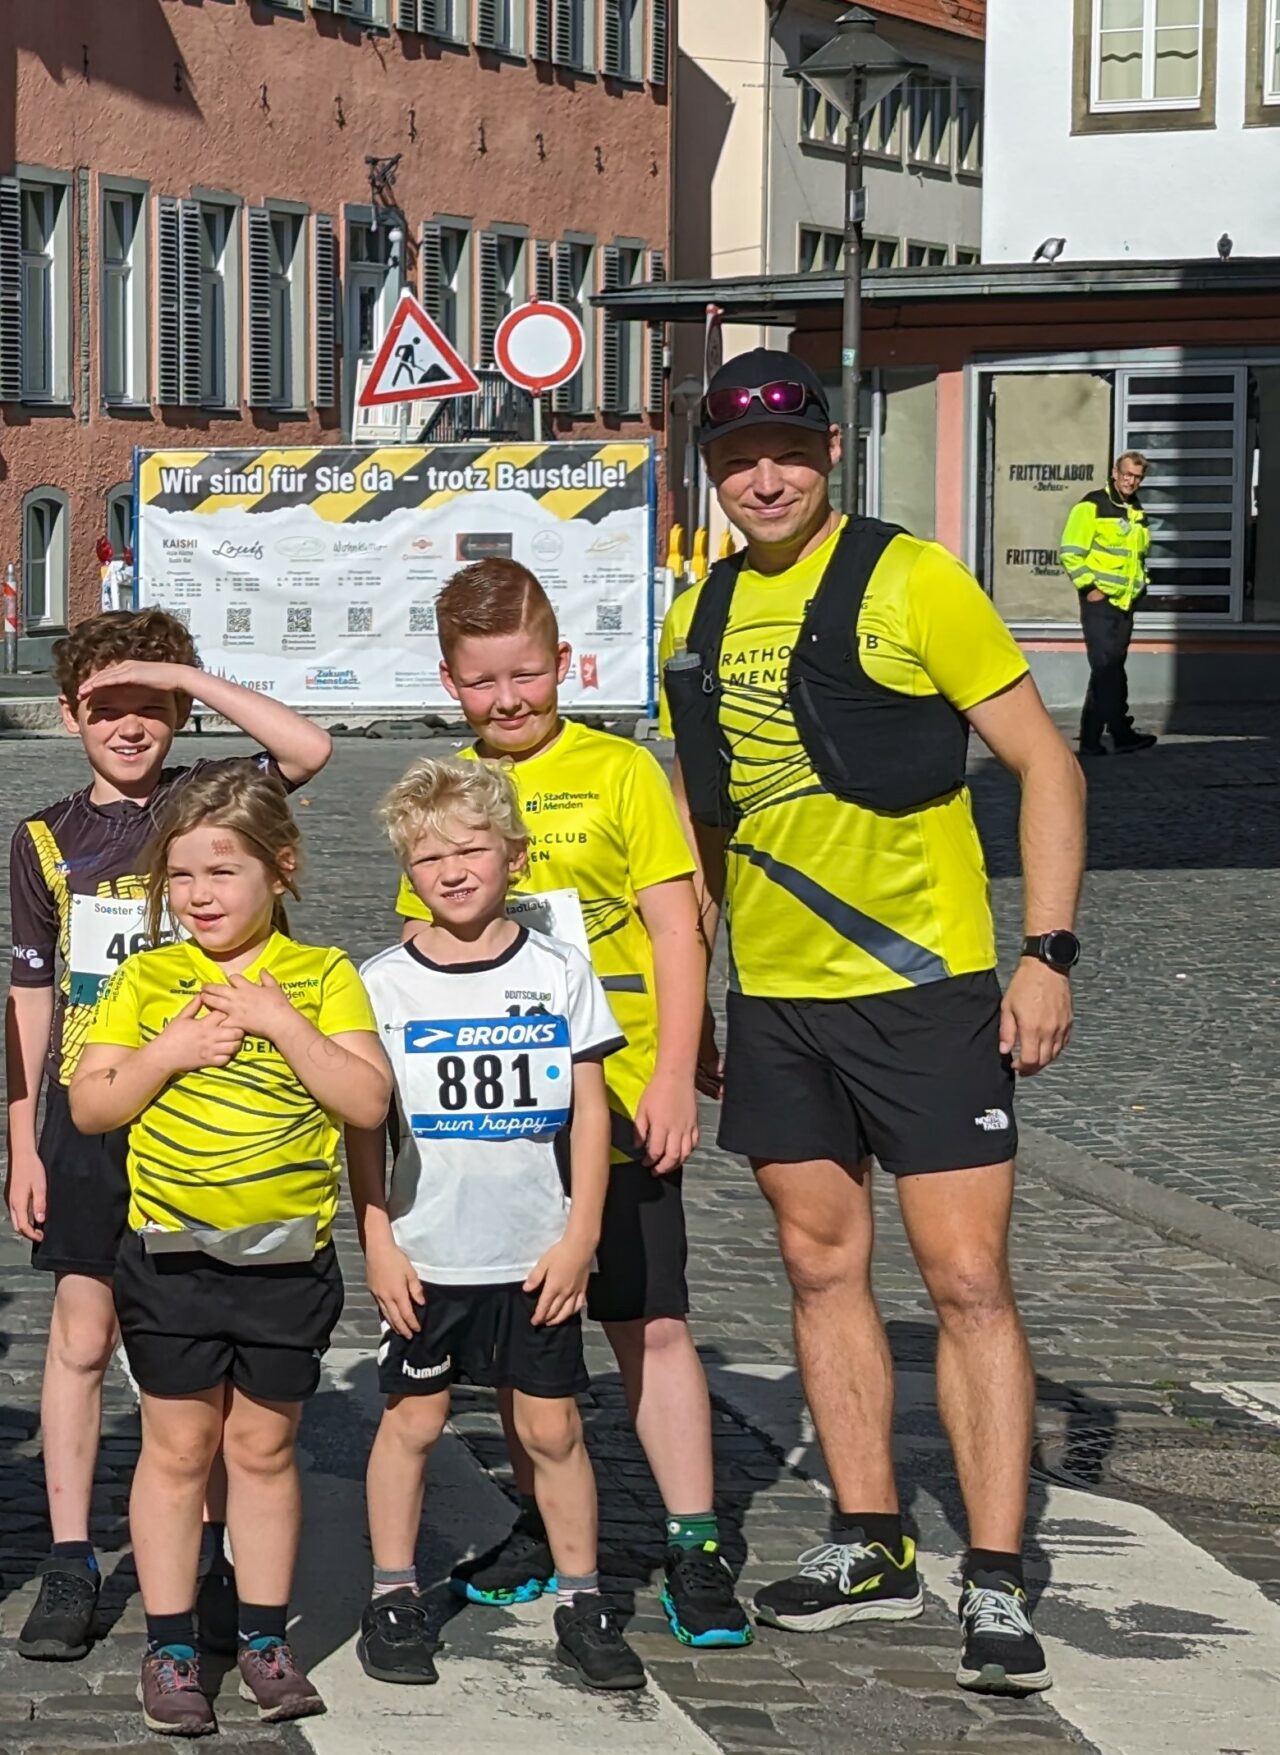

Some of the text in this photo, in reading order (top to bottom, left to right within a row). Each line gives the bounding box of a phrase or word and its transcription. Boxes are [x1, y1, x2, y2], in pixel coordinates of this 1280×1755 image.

[160, 467, 202, 493] Wir
[209, 466, 264, 493] sind
[270, 466, 308, 492] für
[315, 466, 356, 491] Sie
[362, 464, 393, 491] da
[427, 467, 489, 490] trotz
[496, 461, 626, 489] Baustelle!
[1009, 464, 1095, 481] FRITTENLABOR
[162, 539, 198, 549] KAISHI
[1006, 549, 1060, 565] FRITTENL
[721, 645, 792, 667] RATHO
[729, 667, 789, 687] MEND
[543, 792, 600, 801] Stadtwerke
[543, 801, 584, 810] Menden
[527, 832, 588, 846] N-CLUB
[94, 903, 134, 916] Soester
[12, 944, 39, 960] nke
[279, 978, 319, 990] twerke
[286, 990, 306, 1000] den
[456, 1023, 557, 1046] BROOKS
[437, 1053, 538, 1110] 881
[434, 1114, 548, 1134] run happy
[402, 1354, 452, 1379] hummel
